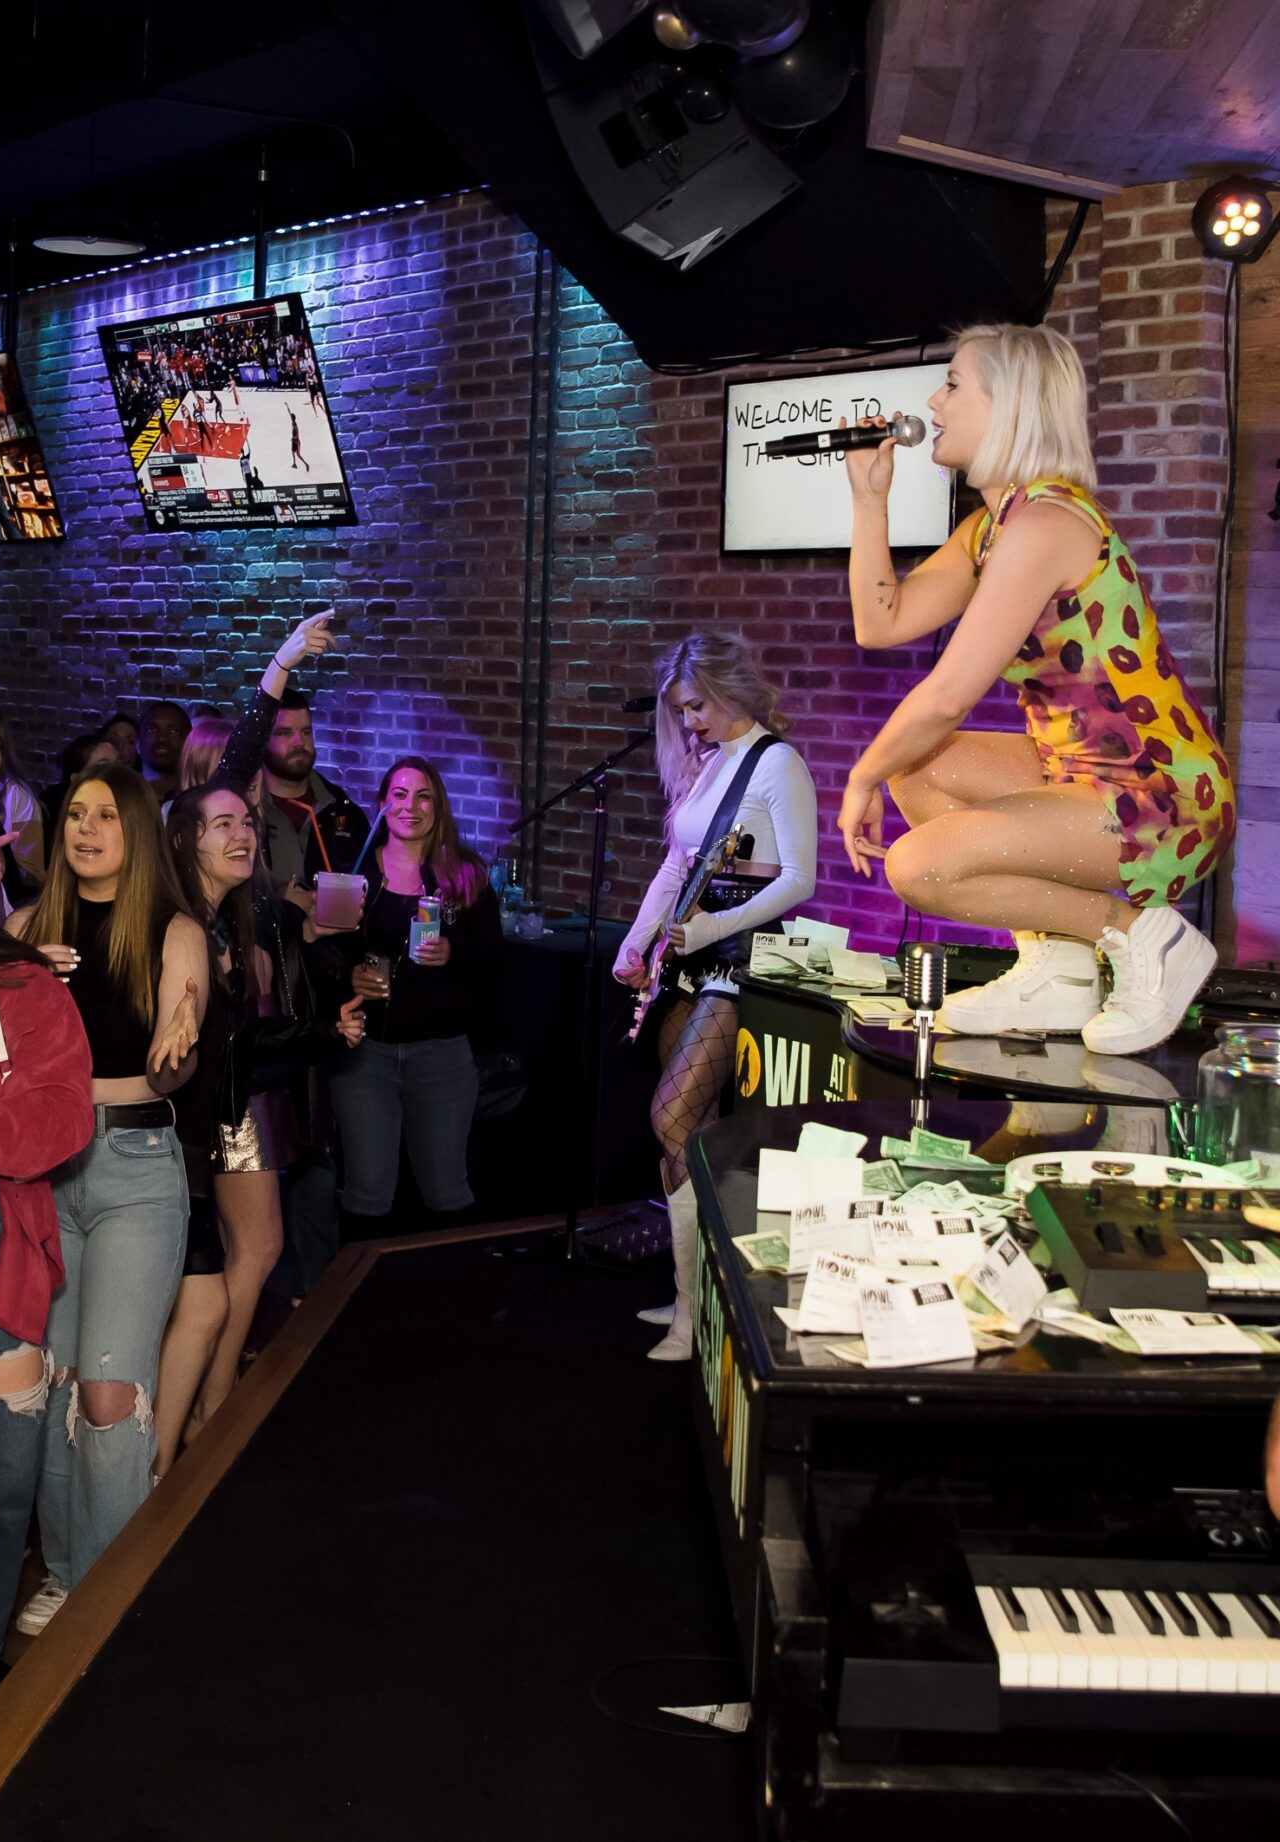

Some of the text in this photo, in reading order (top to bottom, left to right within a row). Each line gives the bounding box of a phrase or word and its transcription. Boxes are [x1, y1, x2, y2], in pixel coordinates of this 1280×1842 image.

[735, 398, 882, 430] WELCOME TO
[829, 1053, 846, 1094] AT
[872, 1219, 912, 1232] HOWL
[816, 1255, 858, 1281] HOWL
[861, 1288, 892, 1305] HOWL
